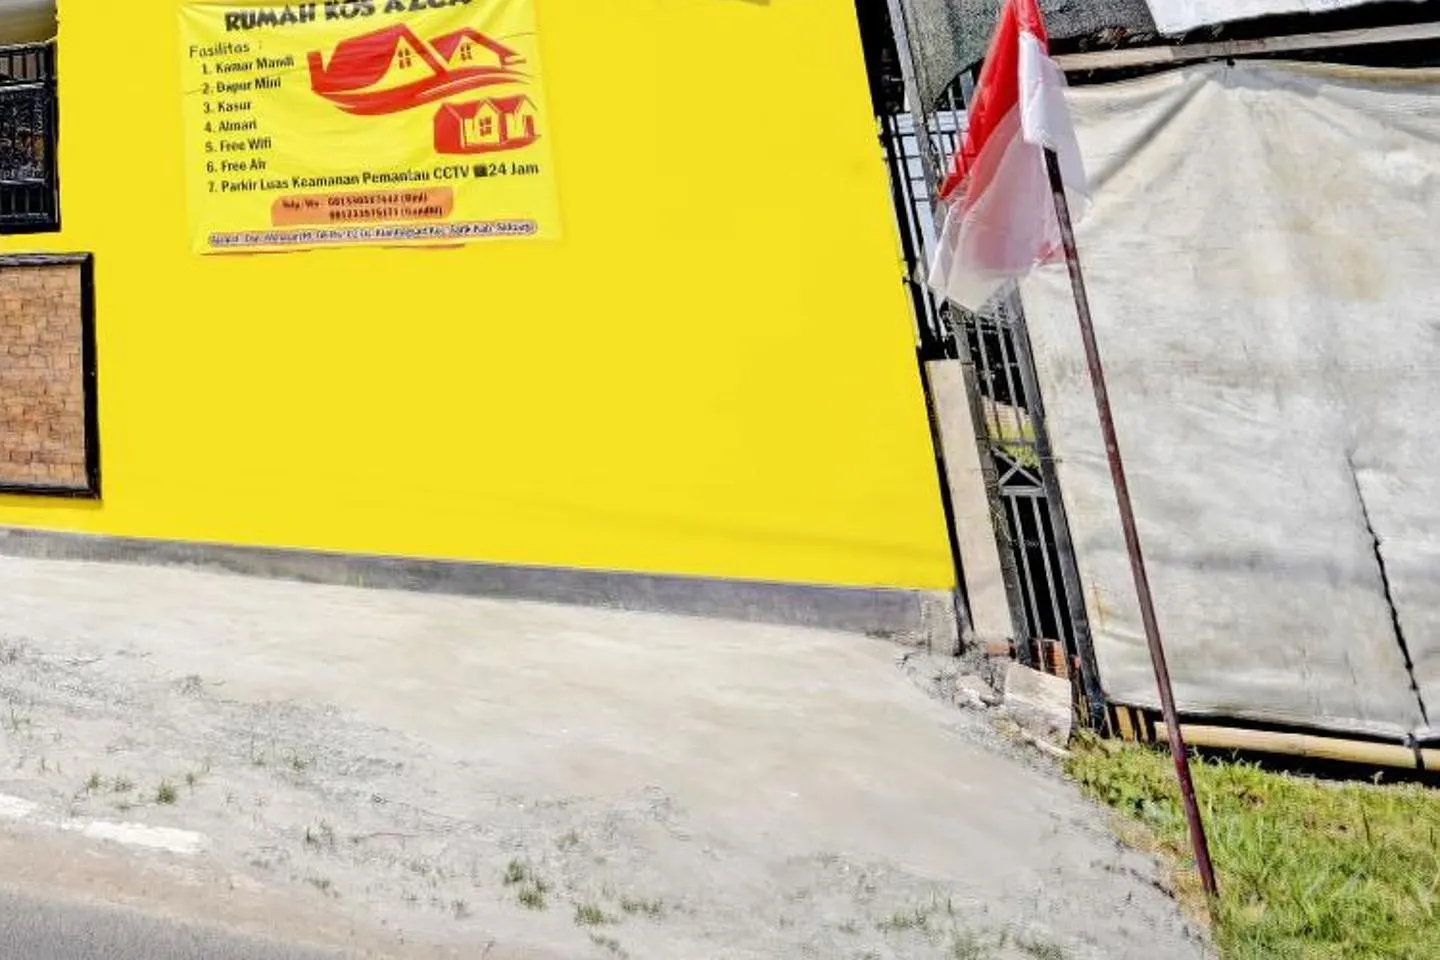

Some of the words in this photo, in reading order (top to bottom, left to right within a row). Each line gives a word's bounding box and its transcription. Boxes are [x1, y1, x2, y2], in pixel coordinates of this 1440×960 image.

[224, 3, 315, 32] RUMAH
[189, 42, 250, 58] Fasilitas
[216, 61, 253, 73] Kamar
[256, 55, 294, 69] Mandi
[254, 77, 281, 89] Mini
[218, 101, 251, 112] Kasur
[218, 119, 257, 131] Almari
[220, 140, 246, 152] Free
[248, 136, 272, 149] Wifi
[221, 159, 247, 172] Free
[249, 158, 266, 170] Air
[221, 179, 257, 193] Parkir
[260, 178, 289, 190] Luas
[292, 174, 360, 189] Keamanan
[362, 169, 430, 184] Pemantau
[433, 164, 470, 180] CCTV
[510, 161, 539, 176] Jam
